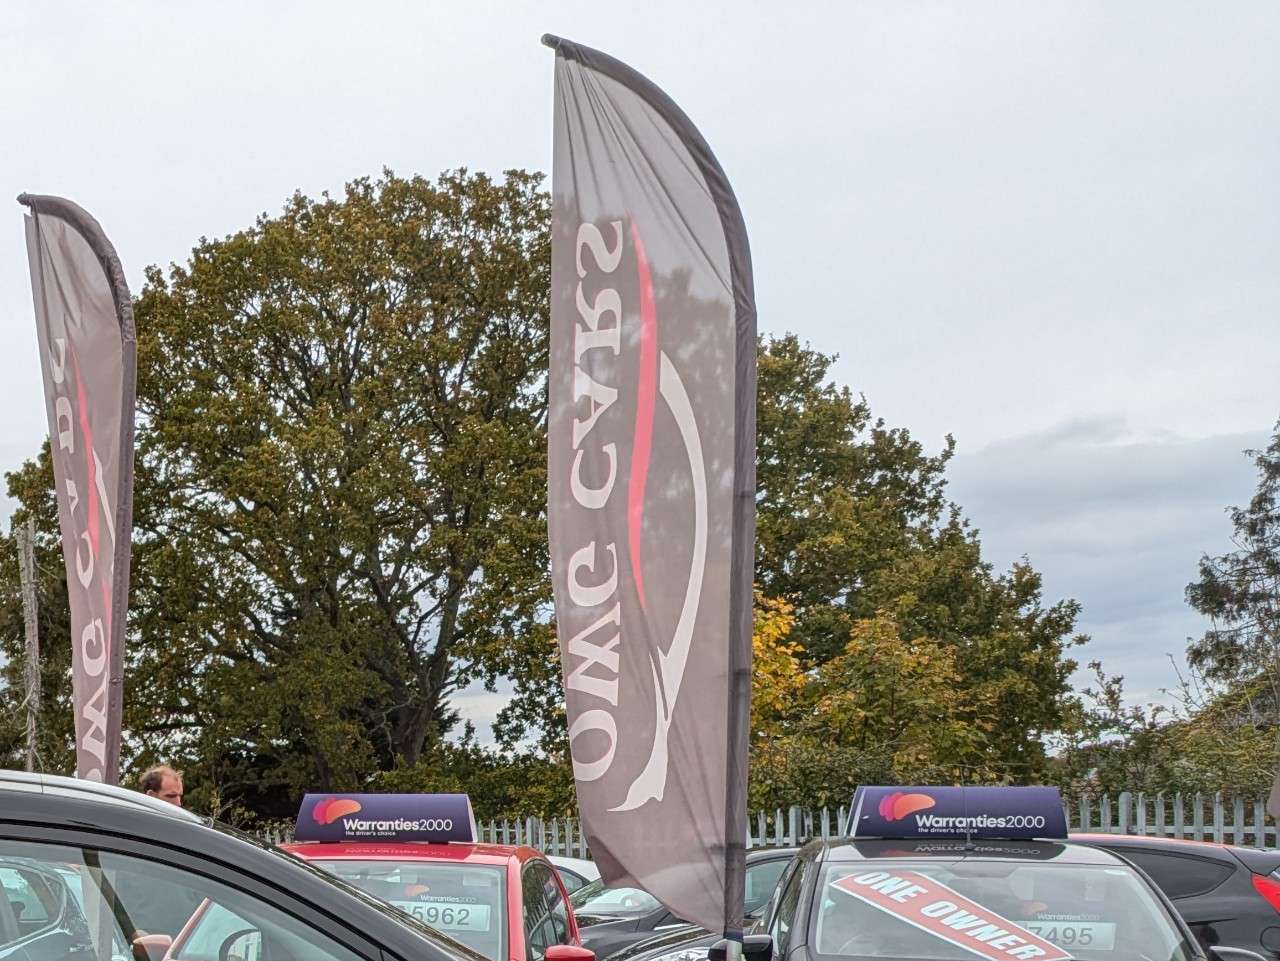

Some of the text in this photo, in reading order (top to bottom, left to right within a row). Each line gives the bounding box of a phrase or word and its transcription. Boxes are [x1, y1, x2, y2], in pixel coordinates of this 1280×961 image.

[343, 817, 453, 832] Warranties2000
[914, 814, 1046, 829] Warranties2000
[397, 904, 470, 926] 5962
[853, 871, 1047, 960] ONE OWNER
